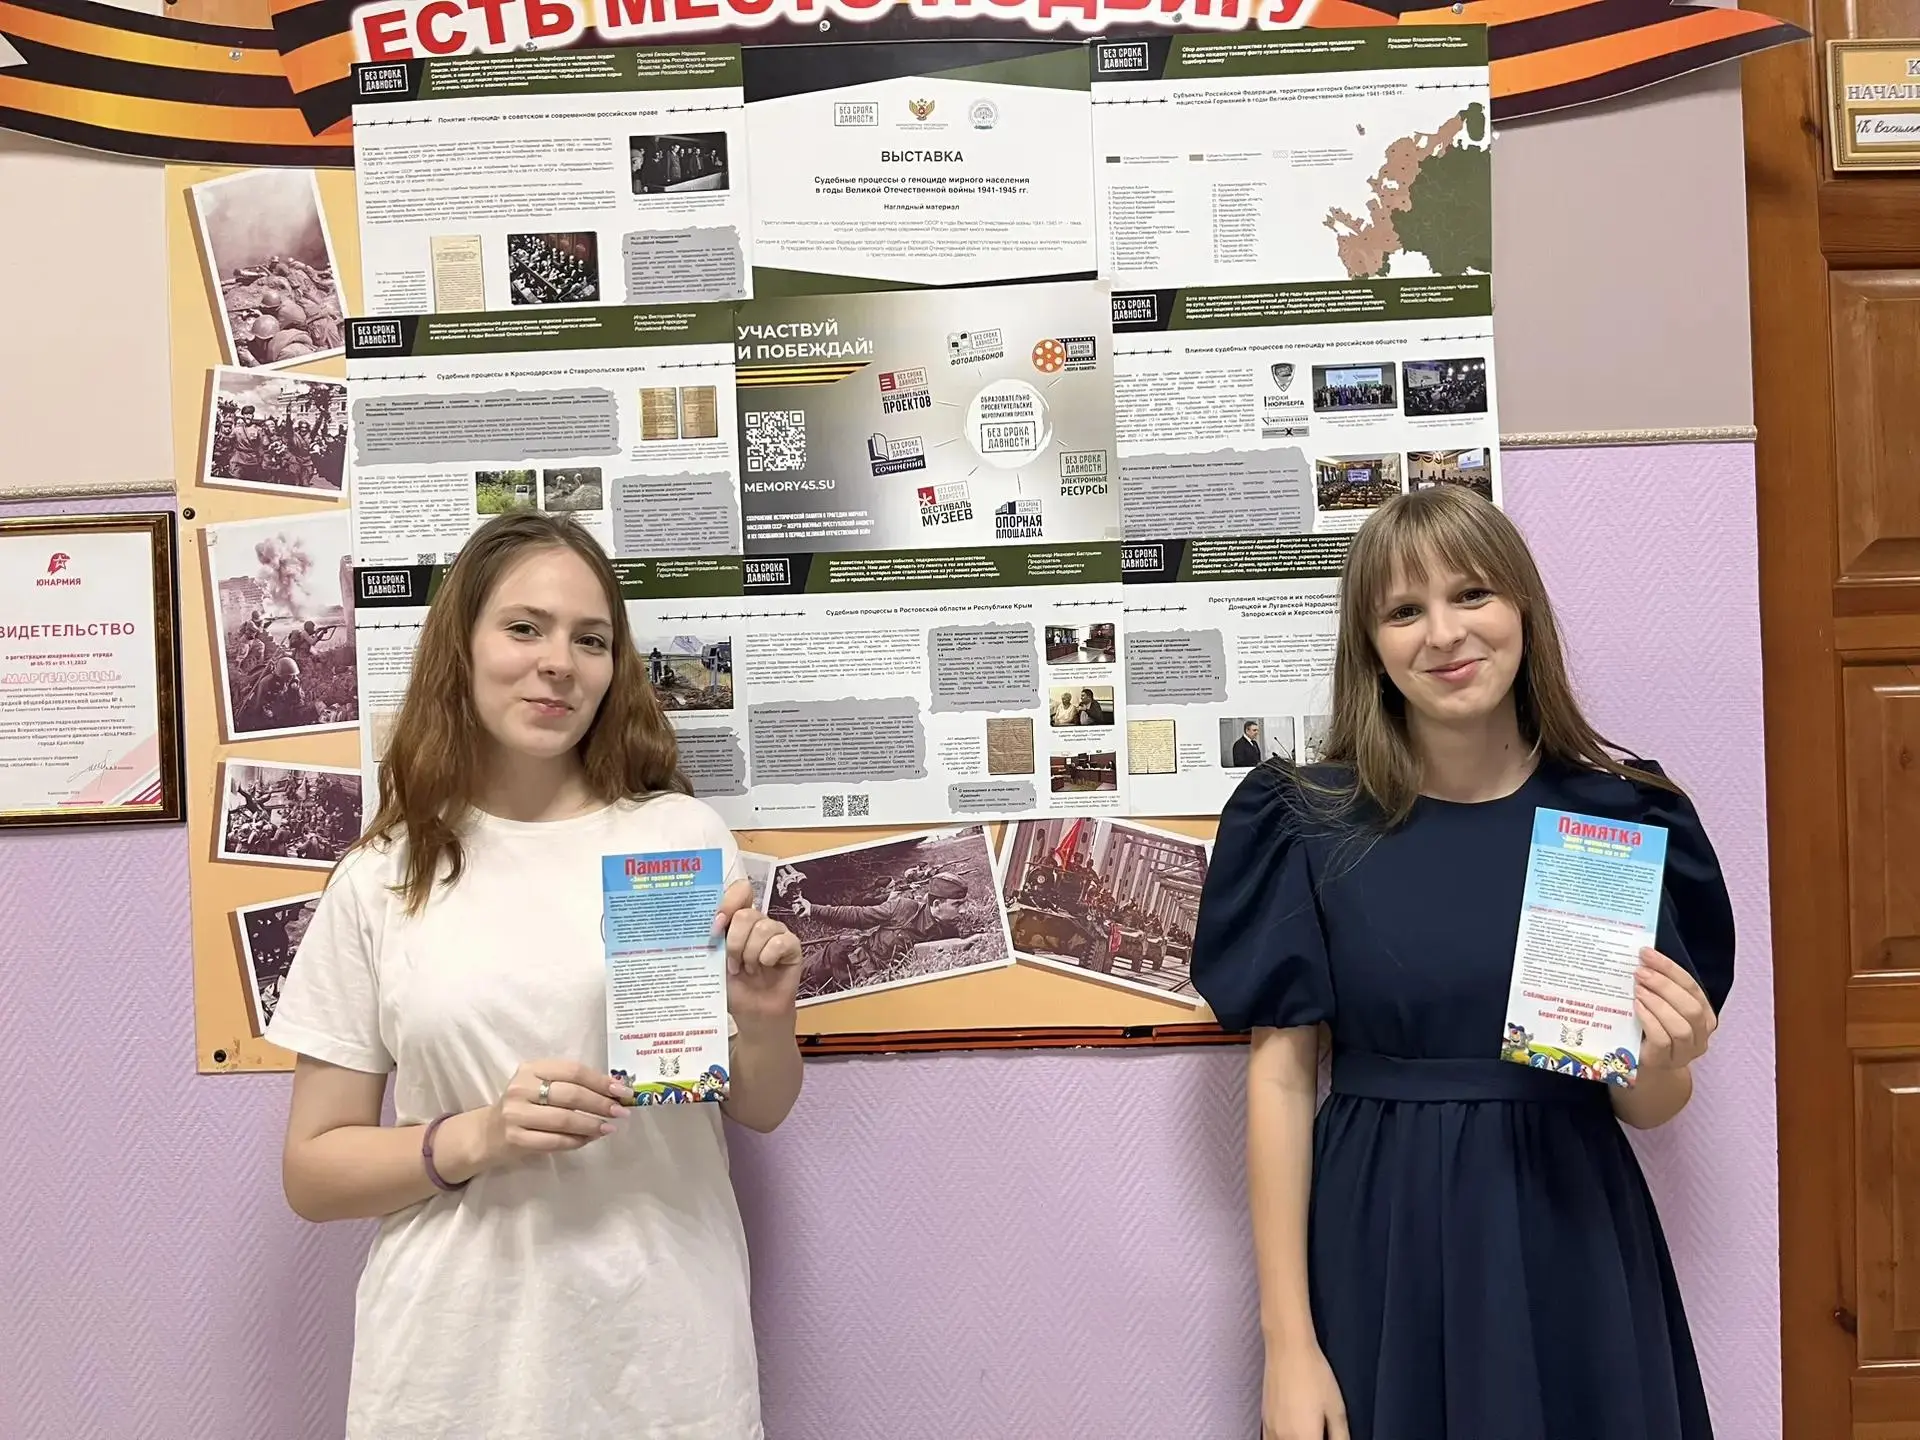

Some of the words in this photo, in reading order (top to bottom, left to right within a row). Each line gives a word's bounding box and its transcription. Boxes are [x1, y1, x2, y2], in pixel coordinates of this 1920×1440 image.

[362, 0, 574, 63] ЕСТЬ
[1103, 49, 1117, 58] БЕЗ
[1118, 47, 1142, 57] СРОКА
[1104, 59, 1143, 69] ДАВНОСТИ
[364, 71, 377, 81] БЕЗ
[378, 69, 401, 80] СРОКА
[365, 80, 403, 91] ДАВНОСТИ
[1361, 83, 1407, 91] оккупированы
[839, 106, 851, 114] БЕЗ
[852, 105, 873, 114] СРОКА
[839, 114, 873, 123] ДАВНОСТИ
[881, 150, 963, 162] ВЫСТАВКА
[814, 176, 856, 184] Судебные
[1113, 300, 1127, 310] БЕЗ
[1127, 299, 1151, 309] СРОКА
[1114, 310, 1152, 321] ДАВНОСТИ
[358, 326, 371, 335] БЕЗ
[372, 325, 395, 334] СРОКА
[737, 318, 838, 339] УЧАСТВУЙ
[358, 336, 396, 346] ДАВНОСТИ
[738, 345, 751, 359] И
[757, 338, 874, 358] ПОБЕЖДАЙ!
[950, 351, 1003, 365] ФОТОАЛЬБОМОВ
[882, 390, 930, 402] ИССЛЕДОВАТЕЛЬСКИХ
[980, 394, 1031, 404] ОБРАЗОВАТЕЛЬНО-
[883, 396, 931, 413] ПРОЕКТОВ
[980, 402, 1032, 410] ПРОСВЕТИТЕЛЬСКИЕ
[987, 428, 1002, 439] БЕЗ
[1004, 426, 1029, 438] СРОКА
[988, 438, 1030, 450] ДАВНОСТИ
[1065, 455, 1077, 465] БЕЗ
[1078, 454, 1101, 464] СРОКА
[1065, 464, 1102, 474] ДАВНОСТИ
[1061, 476, 1107, 484] ЭЛЕКТРОННЫЕ
[744, 480, 835, 492] MEMORY45.SU
[1060, 484, 1107, 496] РЕСУРСЫ
[920, 501, 971, 514] ФЕСТИВАЛЬ
[922, 508, 973, 526] МУЗЕЕВ
[995, 515, 1042, 528] ОПОРНАЯ
[996, 528, 1043, 538] ПЛОЩАДКА
[1134, 549, 1158, 558] СРОКА
[746, 563, 759, 573] БЕЗ
[760, 562, 784, 572] СРОКА
[36, 578, 81, 586] ЮНАРМИЯ
[367, 576, 381, 585] БЕЗ
[382, 575, 404, 584] СРОКА
[746, 573, 785, 584] ДАВНОСТИ
[368, 585, 406, 596] ДАВНОСТИ
[1208, 597, 1256, 605] Преступления
[1228, 603, 1261, 612] Донецкой
[1268, 602, 1303, 611] Луганской
[0, 623, 134, 639] ВИДЕТЕЛЬСТВО
[1558, 816, 1641, 846] Памятка
[625, 858, 701, 875] Памятка
[1522, 990, 1564, 1004] Соблюдайте
[1565, 998, 1594, 1009] правила
[1594, 1004, 1632, 1017] дорожного
[1556, 1006, 1594, 1018] движения!
[1538, 1010, 1569, 1023] Берегите
[1569, 1017, 1590, 1027] своих
[1591, 1021, 1612, 1030] детей
[619, 1032, 657, 1042] Соблюдайте
[658, 1031, 684, 1040] правила
[636, 1048, 664, 1056] Берегите
[664, 1047, 683, 1056] своих
